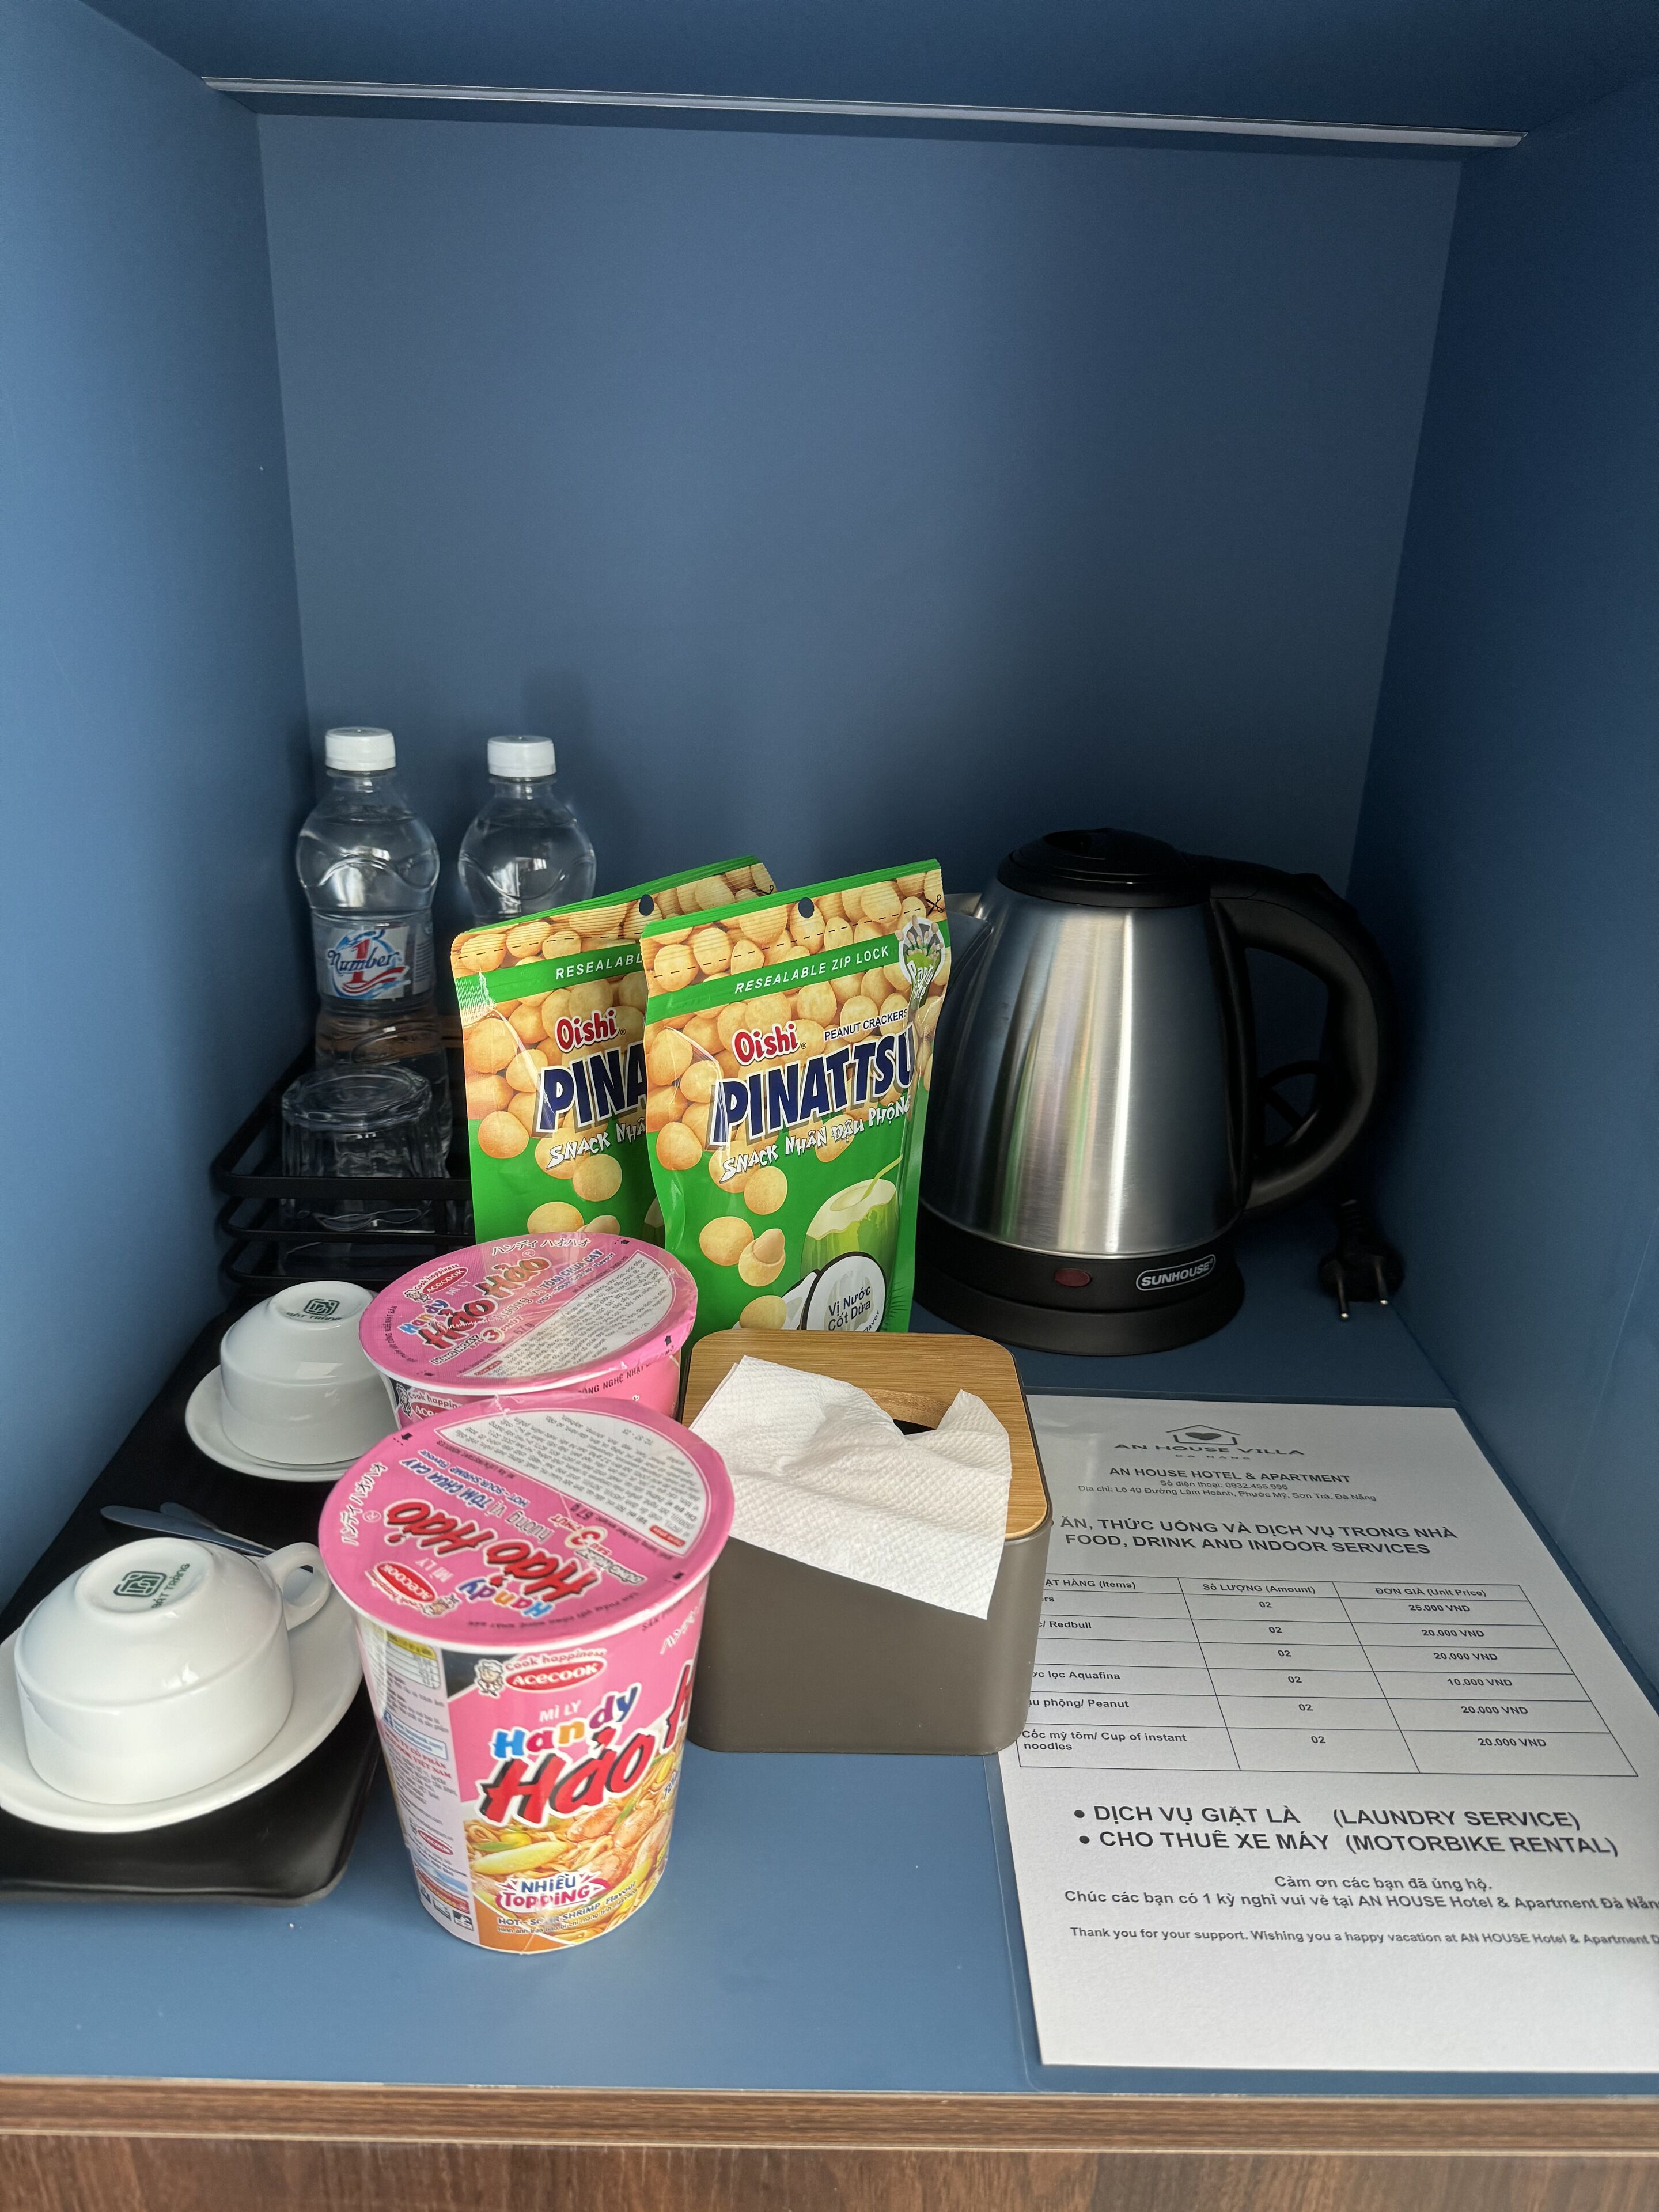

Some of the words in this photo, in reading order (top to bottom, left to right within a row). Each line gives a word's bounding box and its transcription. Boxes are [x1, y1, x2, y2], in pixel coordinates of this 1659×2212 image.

[328, 947, 400, 976] Number
[556, 953, 643, 980] RESEALABL
[734, 961, 826, 994] RESEALABLE
[832, 954, 852, 970] ZIP
[856, 946, 889, 965] LOCK
[555, 1008, 618, 1052] Oishi
[825, 1022, 861, 1041] PEANUT
[863, 1009, 907, 1030] CRACKERS
[734, 1022, 798, 1065] Oishi
[536, 1041, 646, 1134] PINA
[710, 1025, 915, 1146] PINATTSU
[546, 1130, 610, 1170] SNACK
[719, 1145, 779, 1183] SNACK
[785, 1129, 827, 1156] NHÂN
[831, 1116, 865, 1143] ĐẬU
[869, 1100, 911, 1127] PHỘNG
[493, 1240, 537, 1255] ハンディ
[541, 1238, 590, 1247] ハオハオ
[1141, 1262, 1210, 1286] SUNHOUSE
[418, 1298, 498, 1349] Hảo
[474, 1257, 551, 1298] Hảo
[828, 1301, 839, 1316] Vị
[843, 1286, 870, 1310] Nước
[397, 1299, 449, 1334] Handy
[828, 1312, 848, 1331] Cốt
[851, 1301, 870, 1320] Dừa
[1109, 1467, 1131, 1476] AN
[1134, 1468, 1188, 1478] HOUSE
[1191, 1470, 1243, 1479] HOTEL
[1245, 1472, 1256, 1480] &
[1260, 1473, 1350, 1483] APARTMENT
[385, 1499, 494, 1558] Hảo
[1060, 1516, 1093, 1531] ĂN,
[1096, 1517, 1154, 1531] THỨC
[1221, 1521, 1252, 1534] VÀ
[1254, 1524, 1304, 1537] DỊCH
[1305, 1525, 1335, 1539] VỤ
[1338, 1526, 1410, 1538] TRONG
[1413, 1526, 1459, 1539] NHÀ
[1065, 1534, 1127, 1548] FOOD,
[1132, 1536, 1197, 1548] DRINK
[1202, 1539, 1243, 1550] AND
[1247, 1539, 1329, 1552] INDOOR
[1331, 1541, 1431, 1554] SERVICES
[486, 1540, 602, 1603] Hảo
[1062, 1578, 1096, 1587] HÀNG
[1099, 1580, 1136, 1590] (Items)
[1219, 1584, 1263, 1593] LƯỢNG
[1266, 1585, 1316, 1595] (Amount)
[1427, 1588, 1455, 1597] (Unit
[1454, 1589, 1487, 1598] Price)
[459, 1578, 555, 1619] Handy
[1444, 1604, 1471, 1612] VND
[1048, 1620, 1092, 1629] Redbull
[1421, 1629, 1458, 1637] 20.000
[1433, 1652, 1471, 1660] 20.000
[1471, 1653, 1498, 1661] VND
[1047, 1671, 1066, 1680] lọc
[1069, 1671, 1120, 1680] Aquafina
[1447, 1678, 1484, 1687] 10.000
[1485, 1679, 1513, 1687] VND
[1043, 1698, 1084, 1709] phộng/
[1087, 1699, 1130, 1708] Peanut
[1298, 1703, 1314, 1711] 02
[1460, 1706, 1499, 1714] 20.000
[1500, 1706, 1528, 1714] VND
[493, 1683, 639, 1758] Handy
[1022, 1729, 1046, 1739] Cốc
[1049, 1731, 1067, 1741] mỳ
[1070, 1731, 1097, 1740] tôm/
[1101, 1732, 1126, 1743] Cup
[1129, 1733, 1141, 1741] of
[1144, 1733, 1188, 1742] instant
[1024, 1742, 1073, 1751] noodles
[1310, 1736, 1327, 1744] 02
[1477, 1738, 1517, 1747] 20.000
[1518, 1738, 1547, 1747] VND
[478, 1726, 657, 1826] Hảo
[1093, 1805, 1153, 1824] DỊCH
[1157, 1806, 1193, 1826] VỤ
[1201, 1806, 1258, 1827] GIẶT
[1265, 1805, 1301, 1824] LÀ
[1333, 1809, 1455, 1828] (LAUNDRY
[1464, 1810, 1580, 1831] SERVICE)
[1099, 1831, 1153, 1847] CHO
[1159, 1829, 1230, 1849] THUÊ
[1234, 1833, 1271, 1849] XE
[1275, 1830, 1329, 1850] MÁY
[1346, 1834, 1506, 1855] (MOTORBIKE
[1508, 1836, 1618, 1858] RENTAL)
[1274, 1875, 1312, 1888] Cảm
[1315, 1879, 1338, 1888] ơn
[1342, 1876, 1370, 1888] các
[1373, 1877, 1404, 1891] bạn
[1408, 1877, 1429, 1889] đã
[1431, 1877, 1464, 1892] ủng
[1464, 1878, 1493, 1892] hộ.
[562, 1903, 600, 1921] SHRIMP
[605, 1881, 636, 1904] Flavour
[1064, 1890, 1107, 1903] Chúc
[1111, 1891, 1140, 1903] các
[1143, 1892, 1175, 1906] bạn
[1178, 1892, 1198, 1904] có
[1202, 1893, 1211, 1904] 1
[1216, 1893, 1235, 1908] kỳ
[1240, 1893, 1277, 1908] nghỉ
[1279, 1894, 1306, 1906] vui
[1309, 1893, 1330, 1906] vẻ
[1332, 1895, 1354, 1909] tại
[1358, 1895, 1382, 1907] AN
[1385, 1895, 1448, 1908] HOUSE
[1449, 1896, 1494, 1908] Hotel
[1497, 1896, 1510, 1908] &
[1514, 1896, 1599, 1911] Apartment
[1599, 1897, 1624, 1910] Đà
[1069, 1927, 1111, 1937] Thank
[1112, 1930, 1138, 1940] you
[1139, 1928, 1158, 1938] for
[1161, 1931, 1191, 1941] your
[1194, 1930, 1249, 1942] support.
[1249, 1930, 1304, 1943] Wishing
[1306, 1933, 1331, 1943] you
[1334, 1933, 1343, 1941] a
[1344, 1931, 1384, 1944] happy
[1387, 1932, 1442, 1942] vacation
[1444, 1933, 1459, 1943] at
[1461, 1933, 1480, 1943] AN
[1481, 1933, 1531, 1944] HOUSE
[1531, 1933, 1567, 1944] Hotel
[1569, 1933, 1581, 1944] &
[1583, 1934, 1650, 1946] Apartment
